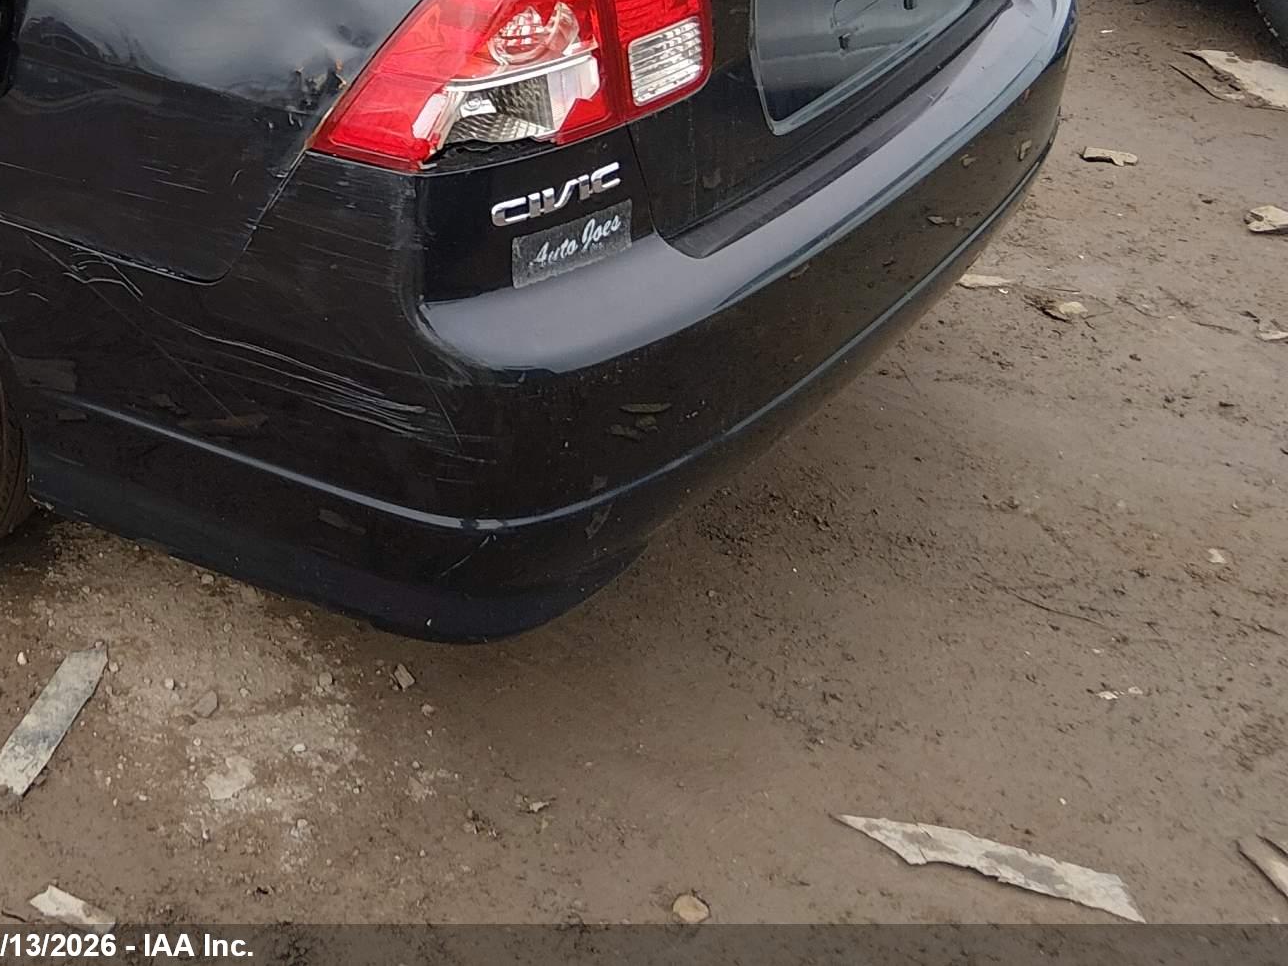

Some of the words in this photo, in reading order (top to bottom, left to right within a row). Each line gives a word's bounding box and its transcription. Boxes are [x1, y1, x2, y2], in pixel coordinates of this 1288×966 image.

[490, 161, 622, 227] CIVIC
[528, 238, 579, 269] Auto
[579, 213, 622, 252] Joes
